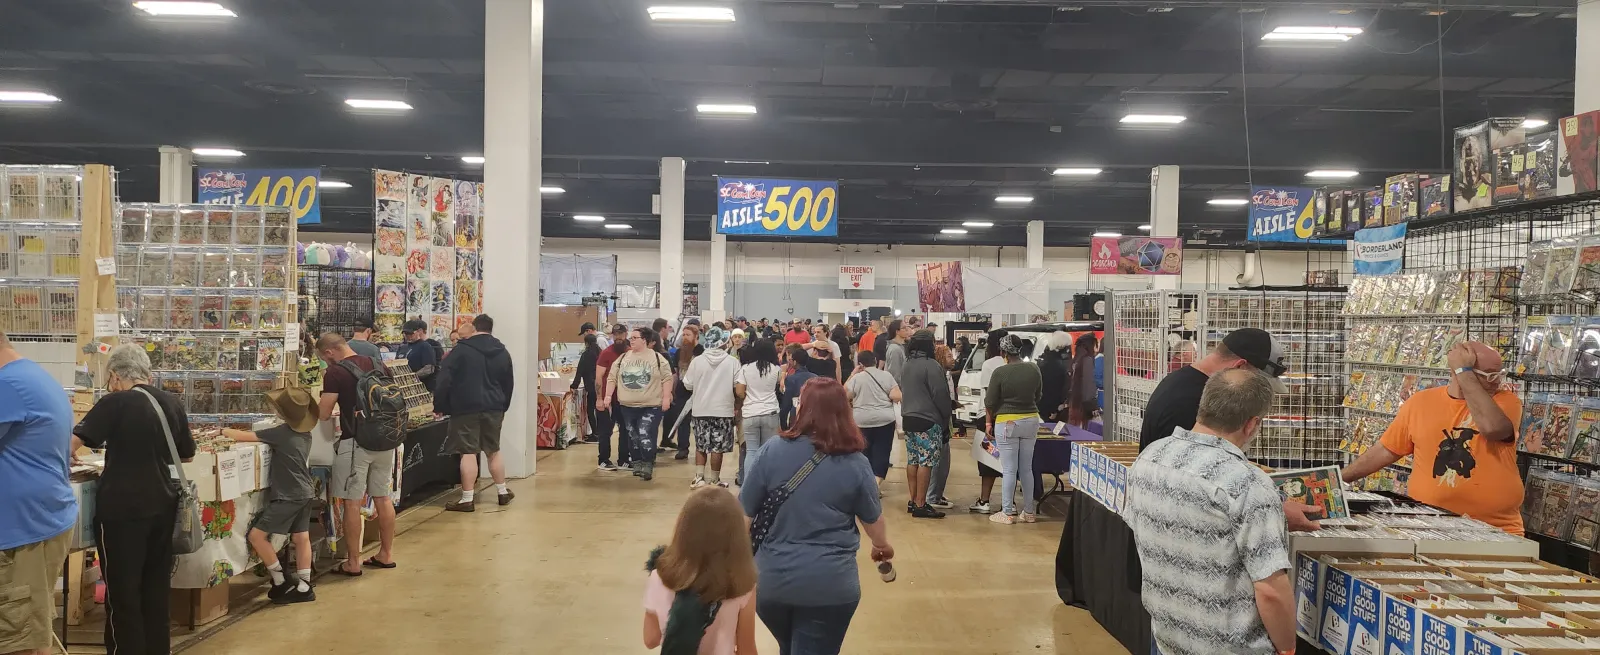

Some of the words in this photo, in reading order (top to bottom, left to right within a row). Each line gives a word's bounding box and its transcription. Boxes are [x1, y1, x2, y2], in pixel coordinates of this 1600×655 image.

[246, 176, 316, 218] 400
[720, 187, 731, 197] SC
[1252, 195, 1264, 205] SC
[722, 203, 764, 228] AISLE
[762, 186, 836, 231] 500
[1252, 211, 1296, 236] AISLE
[1302, 558, 1312, 571] THE
[1299, 566, 1315, 581] GOOD
[1332, 571, 1344, 585] THE
[1297, 577, 1314, 592] STUFF
[1327, 580, 1346, 597] GOOD
[1360, 585, 1372, 599] THE
[1325, 591, 1346, 608] STUFF
[1355, 595, 1376, 612] GOOD
[1353, 606, 1376, 623] STUFF
[1392, 601, 1407, 618] THE
[1389, 613, 1410, 632] GOOD
[1430, 619, 1446, 636] THE
[1387, 625, 1411, 643] STUFF
[1425, 630, 1450, 651] GOOD
[1424, 642, 1450, 655] STUF
[1473, 638, 1491, 655] THE
